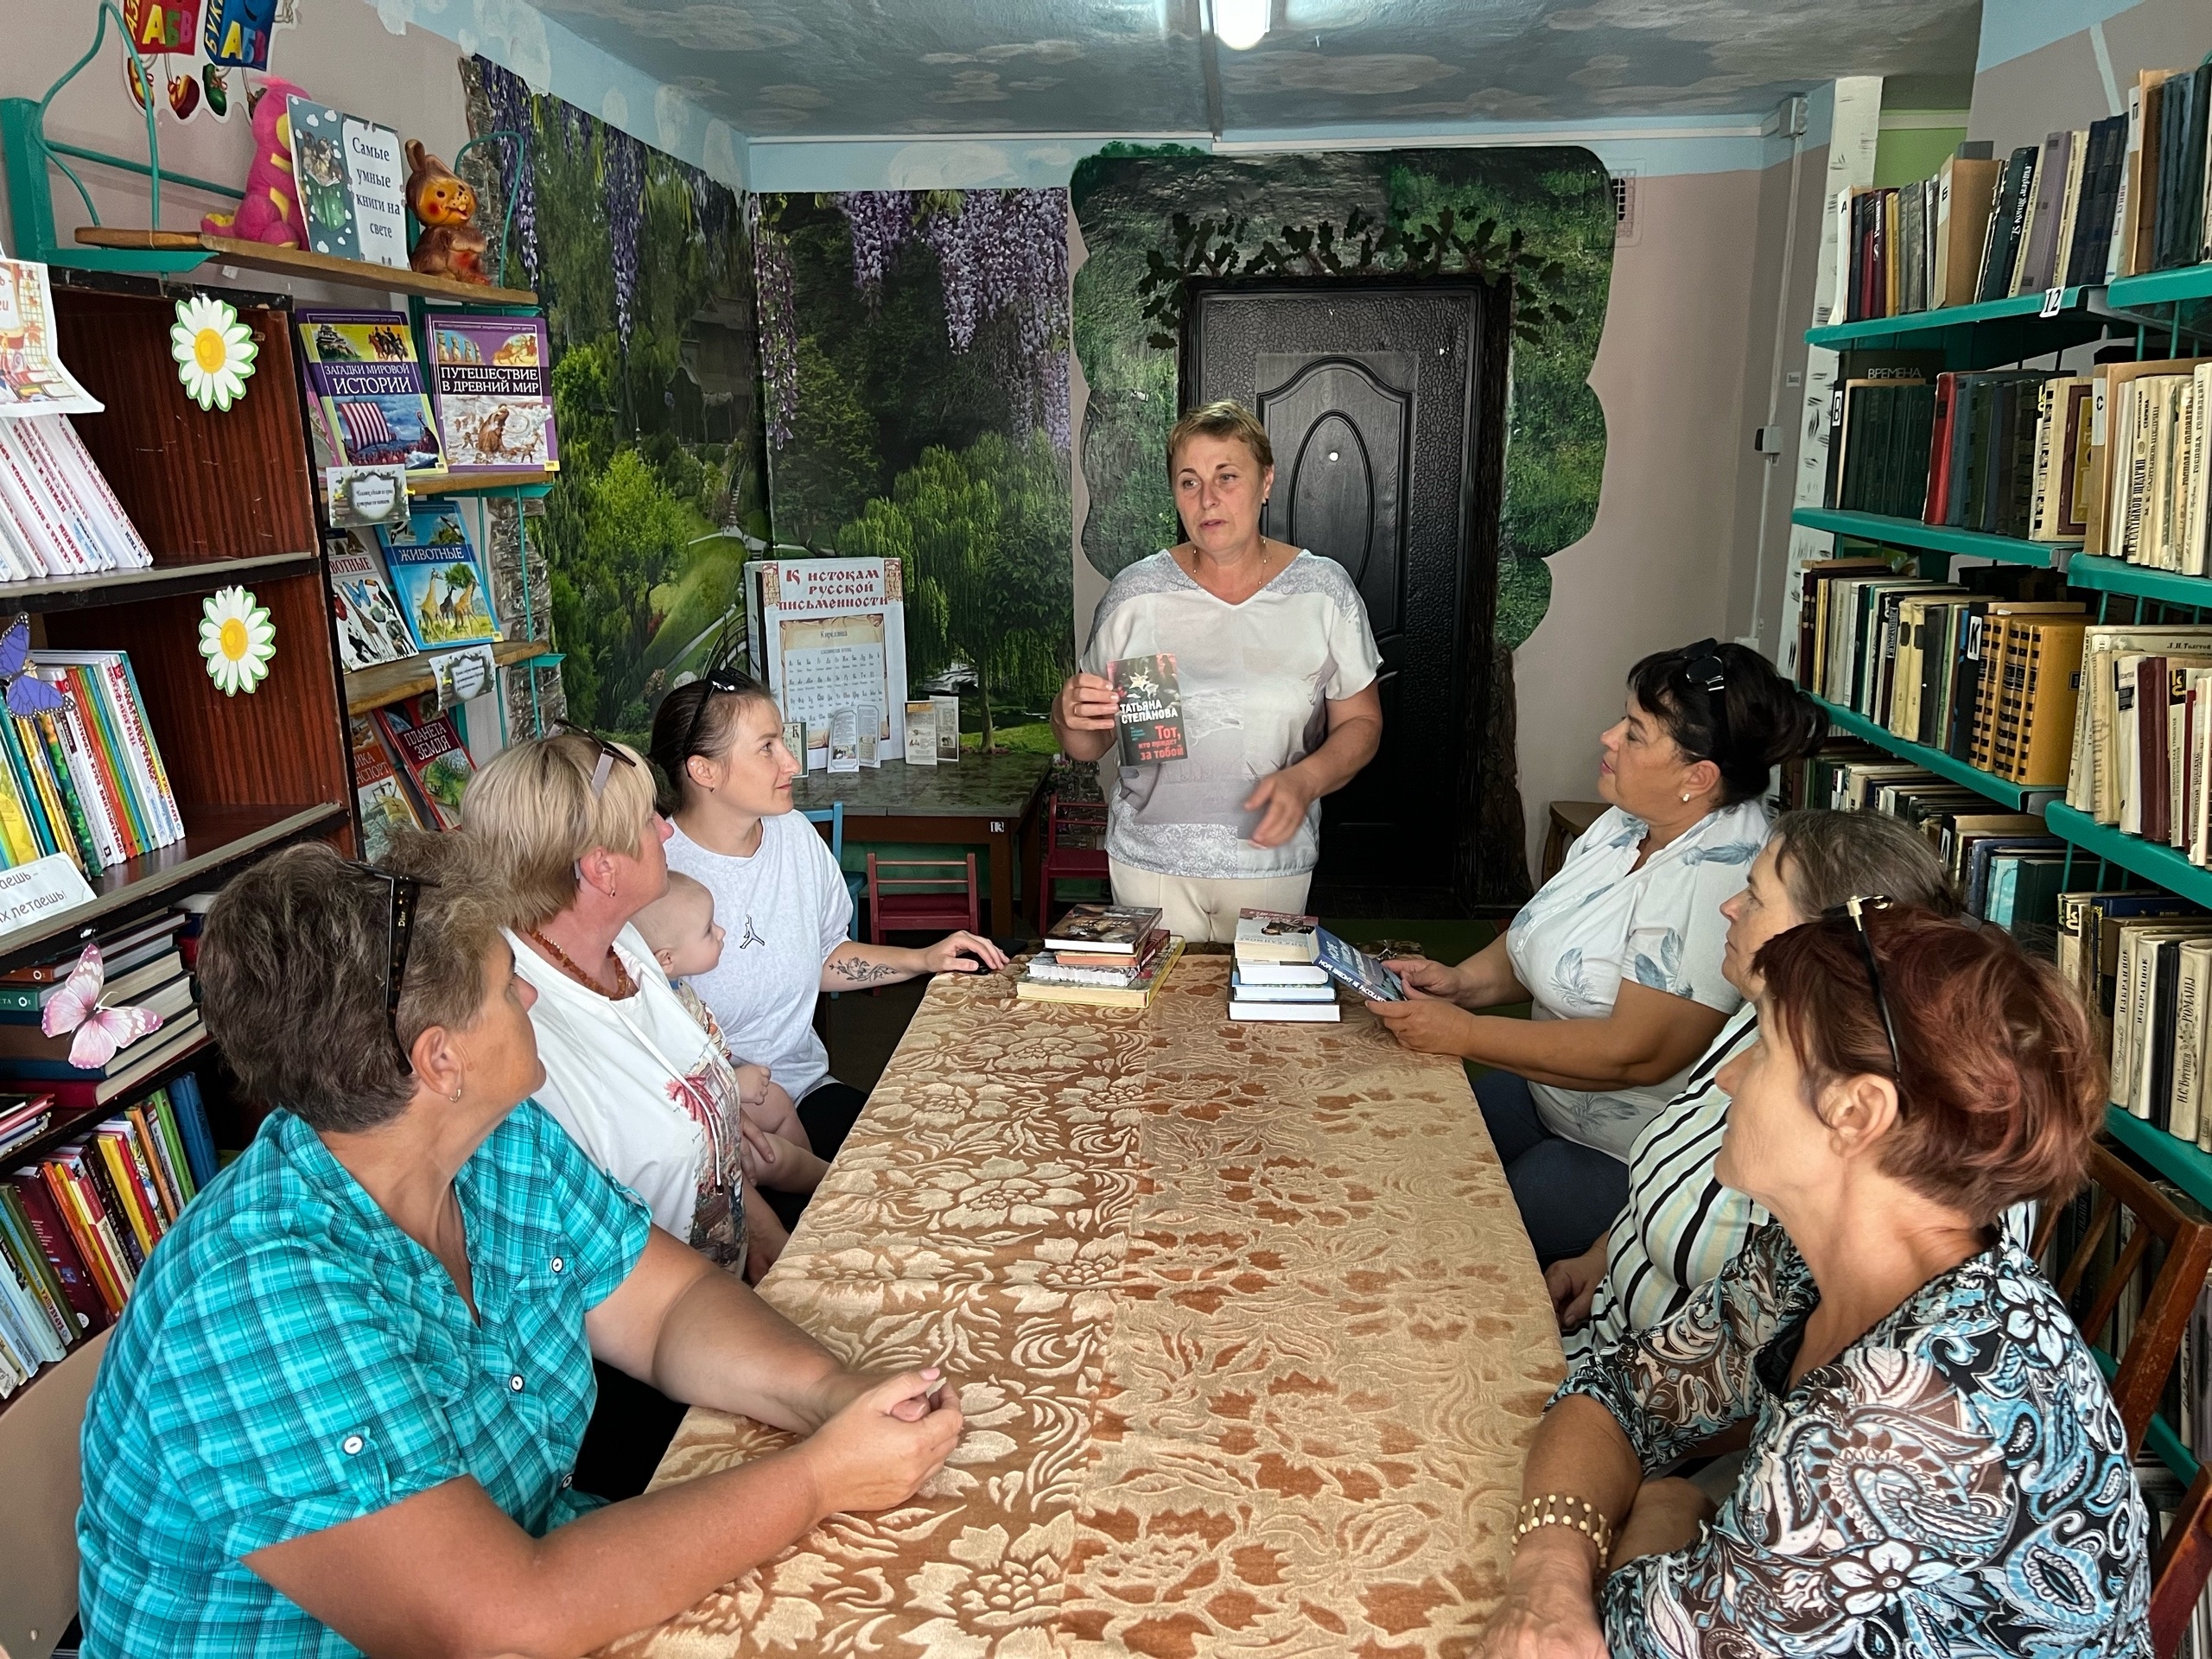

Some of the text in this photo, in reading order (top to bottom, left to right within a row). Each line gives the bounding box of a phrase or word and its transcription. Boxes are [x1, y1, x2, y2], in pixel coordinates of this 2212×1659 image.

[142, 4, 193, 48] АБВ
[220, 21, 266, 63] АБВ
[352, 137, 390, 162] Самые
[356, 168, 391, 188] умные
[356, 194, 400, 215] книги на
[1942, 186, 1949, 202] Б
[1840, 200, 1848, 215] А
[370, 222, 392, 238] свете
[2044, 289, 2061, 314] 12
[325, 363, 410, 375] ЗАГАДКИ МИРОВОЙ
[441, 367, 538, 380] ПУТЕШЕСТВИЕ
[1867, 366, 1922, 380] ВРЕМЕНА
[333, 377, 412, 394] ИСТОРИИ
[442, 379, 539, 393] В ДРЕВНИЙ МИР
[2096, 396, 2104, 411] С
[10, 423, 39, 465] НИЩИЙ
[33, 448, 56, 481] РОЗОВОЙ
[35, 466, 45, 476] И
[2182, 449, 2190, 486] ГОСПОДА
[9, 462, 47, 521] ПОТЕРЯННОМ
[42, 476, 67, 512] ПРИНЦ
[56, 420, 143, 559] М. ТВЕН ПРИКЛЮЧЕНИЯ ТОМА СОЙЕРА
[48, 530, 71, 563] СКАЗКА
[56, 522, 84, 563] БЫЛИНЫ
[398, 546, 465, 562] ЖИВОТНЫЕ
[330, 556, 372, 575] ВОТНЫЕ
[786, 569, 800, 586] К
[1969, 620, 1981, 655] К
[1120, 699, 1163, 714] ТАТЬЯНА
[1121, 708, 1179, 724] СТЕПАНОВА
[25, 717, 37, 738] СЛЕД
[72, 707, 93, 760] КУРОЛЕСОВ
[404, 721, 448, 747] ПЛАНЕТА
[1154, 725, 1181, 740] Тот,
[414, 735, 452, 761] ЗЕМЛЯ
[1141, 745, 1184, 760] за тобой
[89, 762, 102, 785] ВАСИ
[356, 761, 390, 785] НСПОРТ
[45, 775, 61, 811] КОЛОБОК
[160, 776, 180, 822] БАРАБАШКА
[98, 788, 124, 854] ПРИКЛЮЧЕНИЯ
[1319, 959, 1333, 971] МОРЕ
[1332, 967, 1353, 983] НИКОМУ
[1352, 980, 1361, 988] НЕ
[2120, 948, 2128, 1013] ИЗБРАННОЕ
[2136, 958, 2147, 1023] ИЗБРАННОЕ
[2182, 976, 2195, 1023] РОМАНЫ
[125, 1258, 139, 1281] ВНИМ
[39, 1288, 65, 1331] БАРАБАШКА
